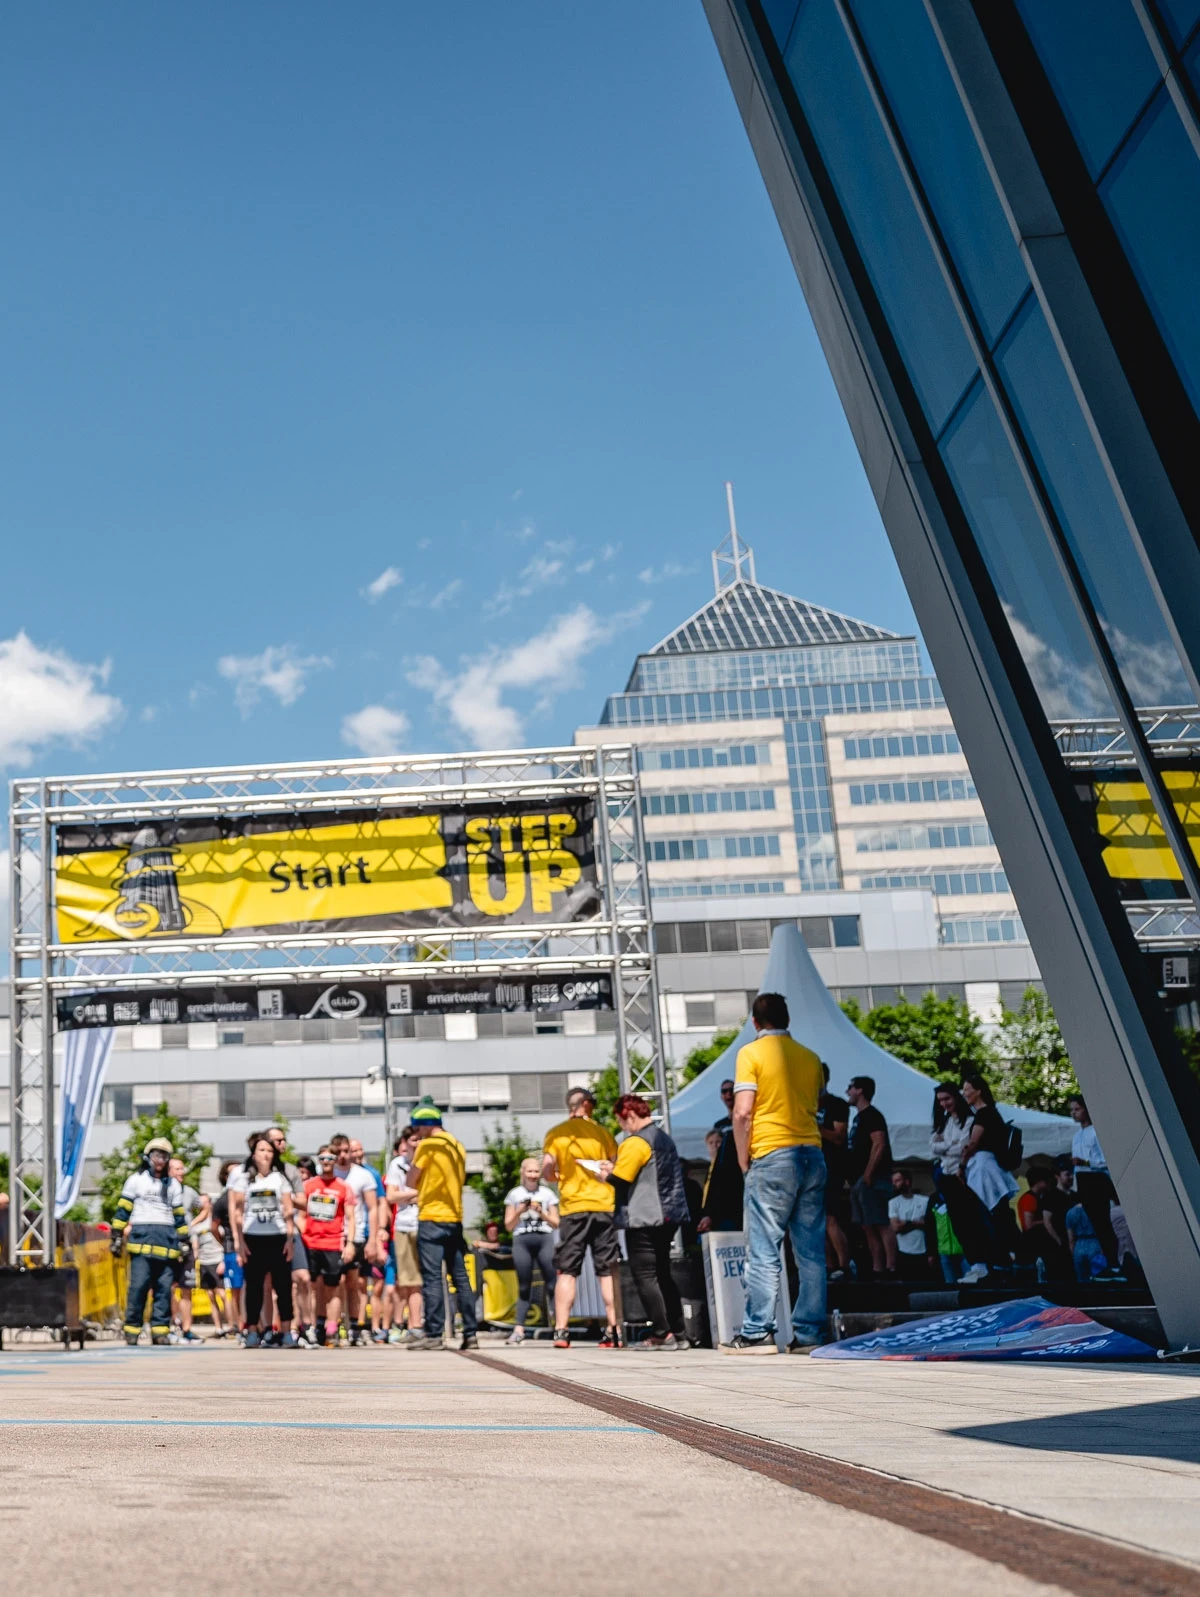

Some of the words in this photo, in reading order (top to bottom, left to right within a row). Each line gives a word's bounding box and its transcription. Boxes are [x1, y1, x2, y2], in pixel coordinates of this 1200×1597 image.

[465, 813, 578, 853] STEP
[268, 856, 372, 894] Start
[466, 850, 582, 917] UP
[723, 1260, 746, 1278] JEK
